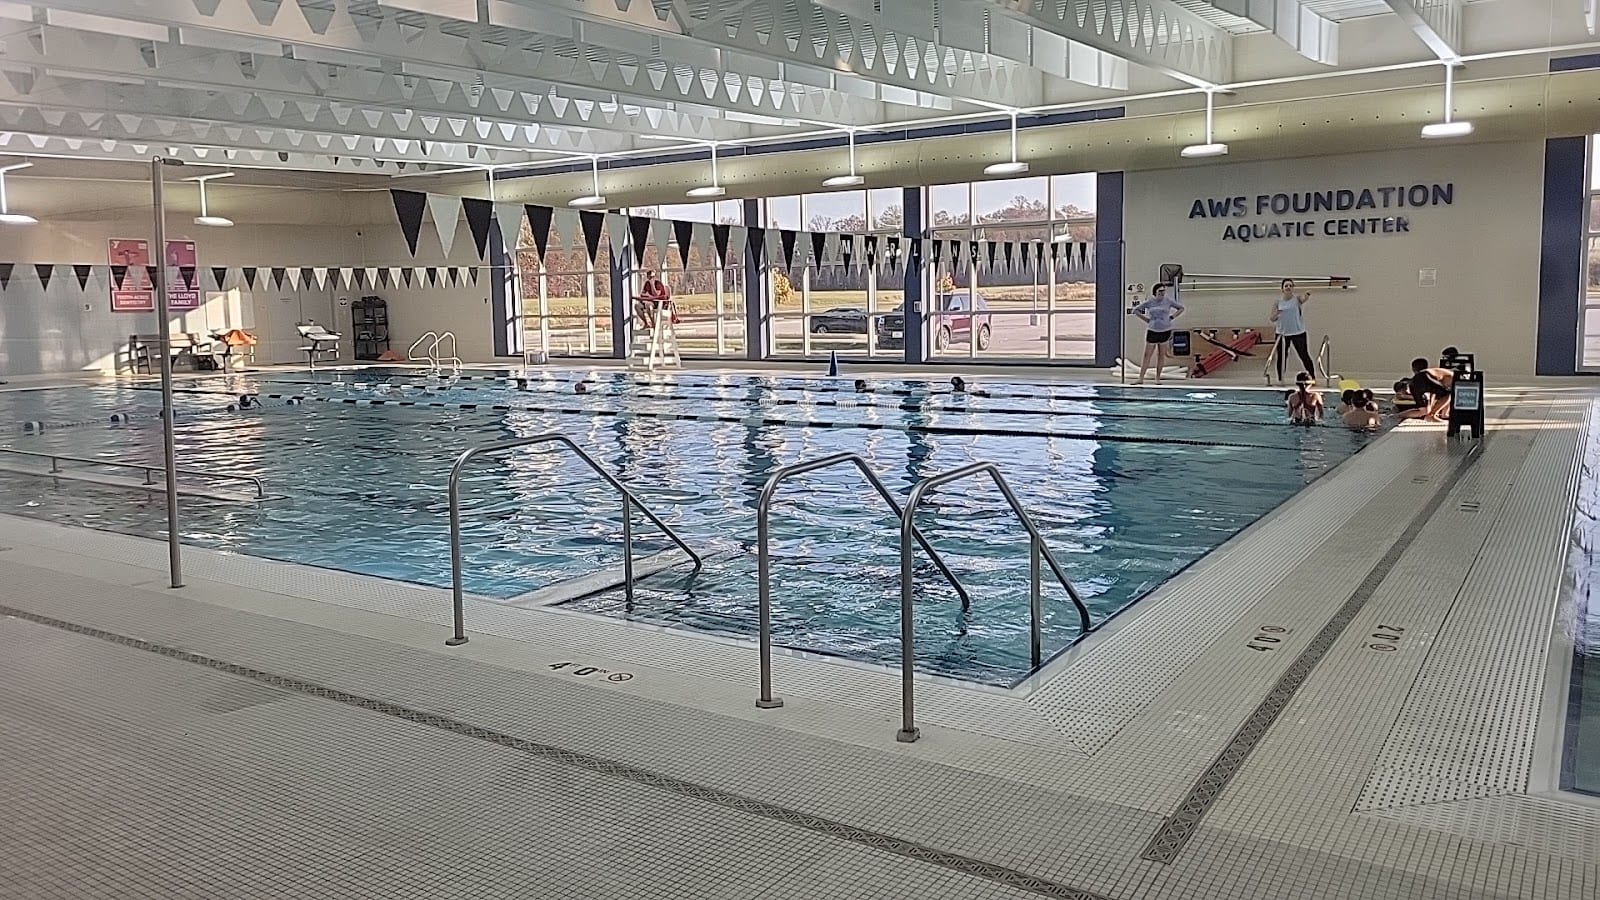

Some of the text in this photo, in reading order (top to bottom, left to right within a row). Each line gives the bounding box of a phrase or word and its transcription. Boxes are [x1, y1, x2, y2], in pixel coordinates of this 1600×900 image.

[1188, 183, 1453, 219] AWS FOUNDATION
[1222, 216, 1410, 243] AQUATIC CENTER
